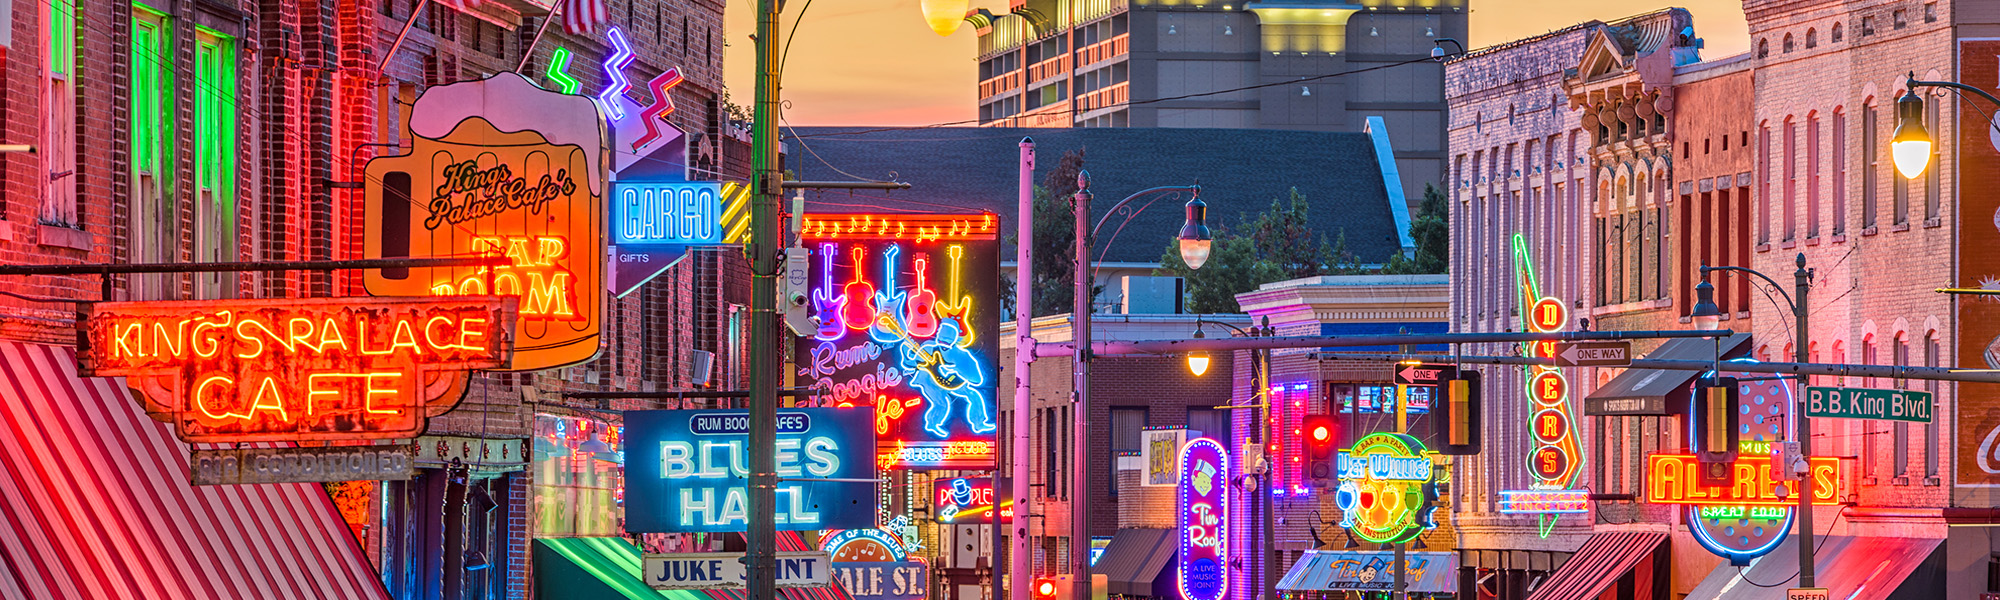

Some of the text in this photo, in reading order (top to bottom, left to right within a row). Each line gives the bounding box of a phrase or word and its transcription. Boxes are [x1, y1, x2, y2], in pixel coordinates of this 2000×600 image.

[436, 160, 511, 198] Kings
[424, 168, 576, 231] Palace Cafe's
[622, 188, 714, 239] CARGO
[472, 235, 567, 275] TAP
[619, 253, 650, 263] GIFTS
[1577, 348, 1623, 359] ONE WAY
[1413, 369, 1432, 379] ONE
[197, 372, 403, 421] CAFE
[1810, 391, 1930, 419] B.B. King Blvd.
[697, 416, 803, 431] RUM BOO AFE'S
[1741, 442, 1770, 454] MUS
[201, 452, 408, 478] AIR CONDITIONED
[1655, 458, 1834, 500] ALRES
[1191, 503, 1219, 526] Tin
[1702, 507, 1786, 518] GREAT FOOD
[1188, 525, 1220, 556] Roof
[1363, 519, 1408, 539] INSTITUTION
[656, 558, 817, 583] JUKE INT
[832, 566, 924, 596] ALE ST.
